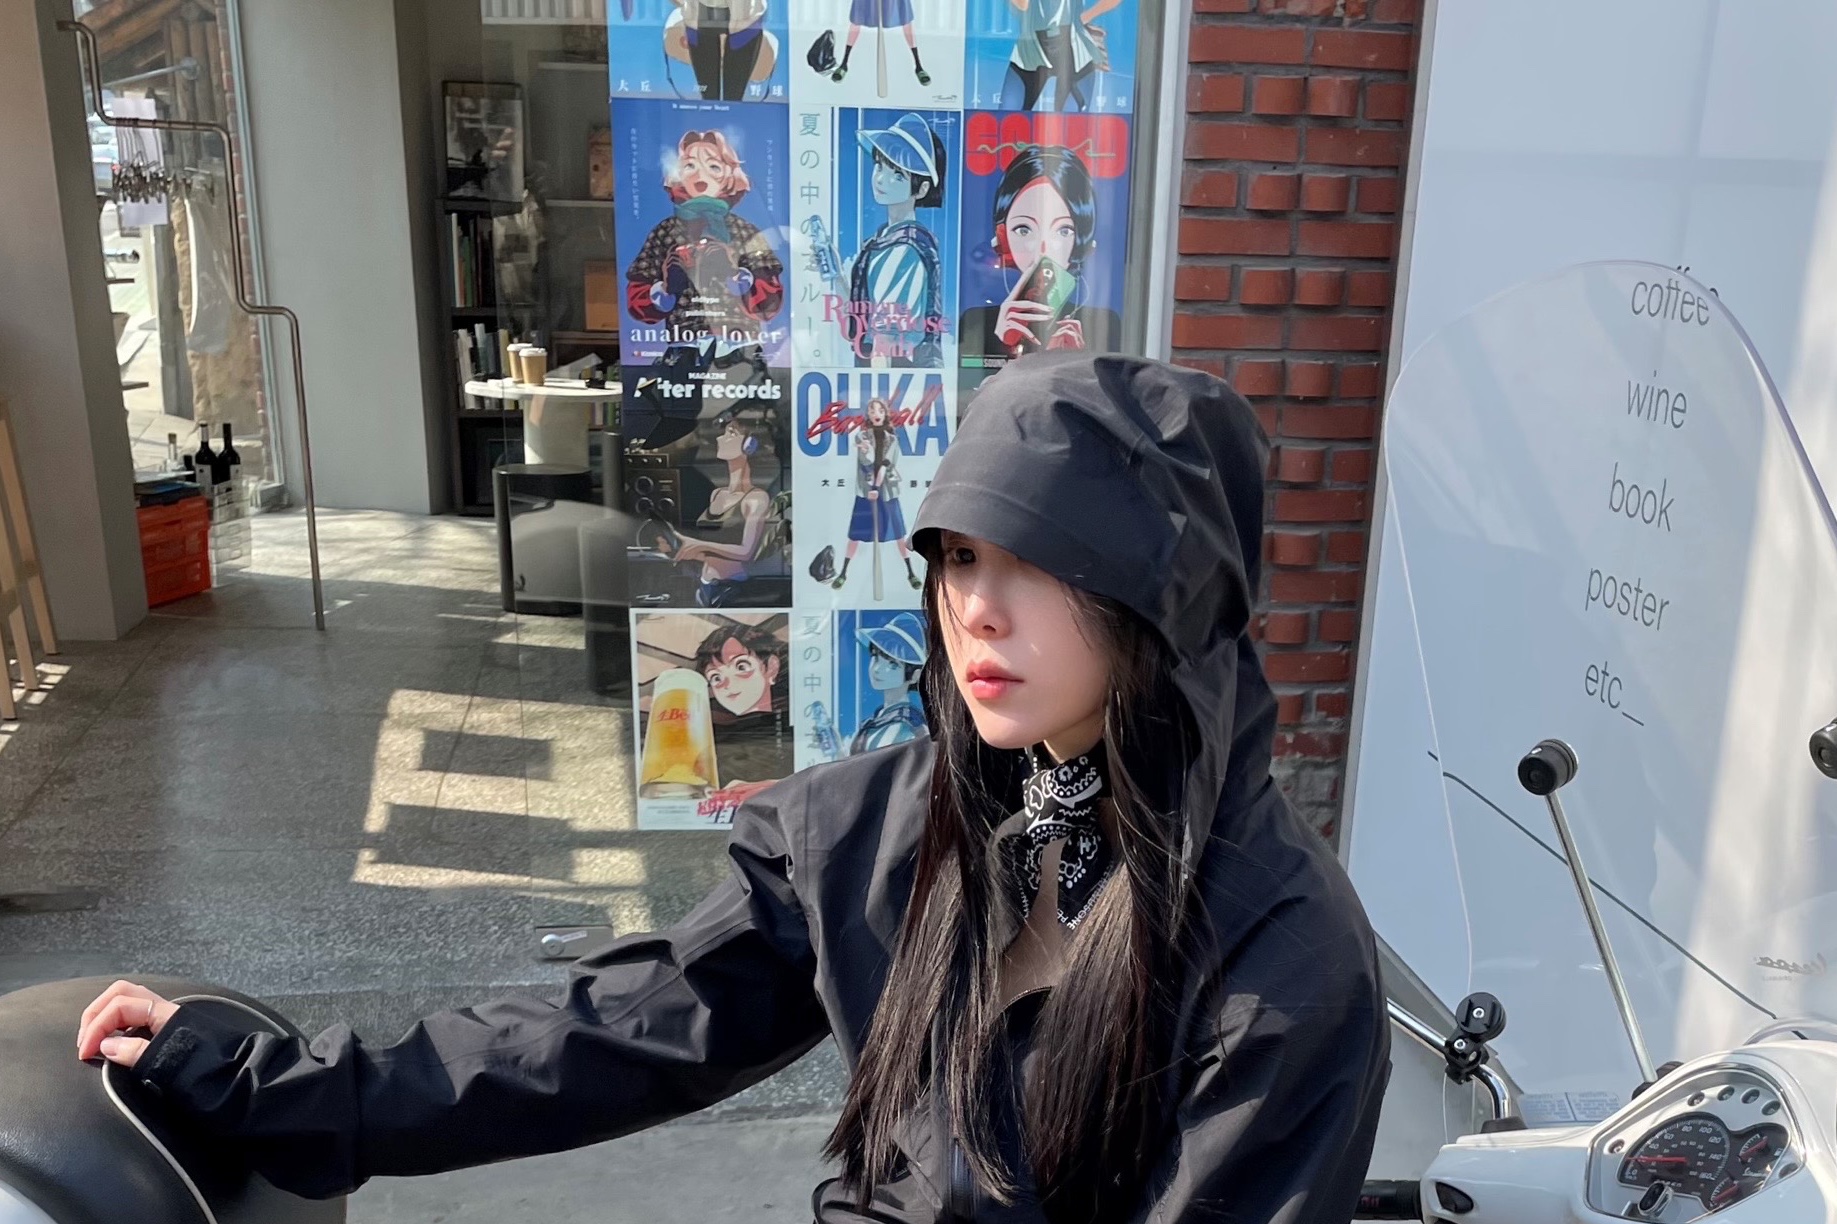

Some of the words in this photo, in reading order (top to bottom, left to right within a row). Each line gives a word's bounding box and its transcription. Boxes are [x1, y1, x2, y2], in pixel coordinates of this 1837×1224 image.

[1631, 275, 1711, 327] coffee
[630, 324, 709, 345] analog
[688, 372, 727, 380] MAGAZINE
[701, 379, 782, 400] records
[1626, 370, 1687, 429] wine
[796, 371, 950, 458] OHKA
[1608, 461, 1675, 532] book
[1584, 567, 1670, 631] poster
